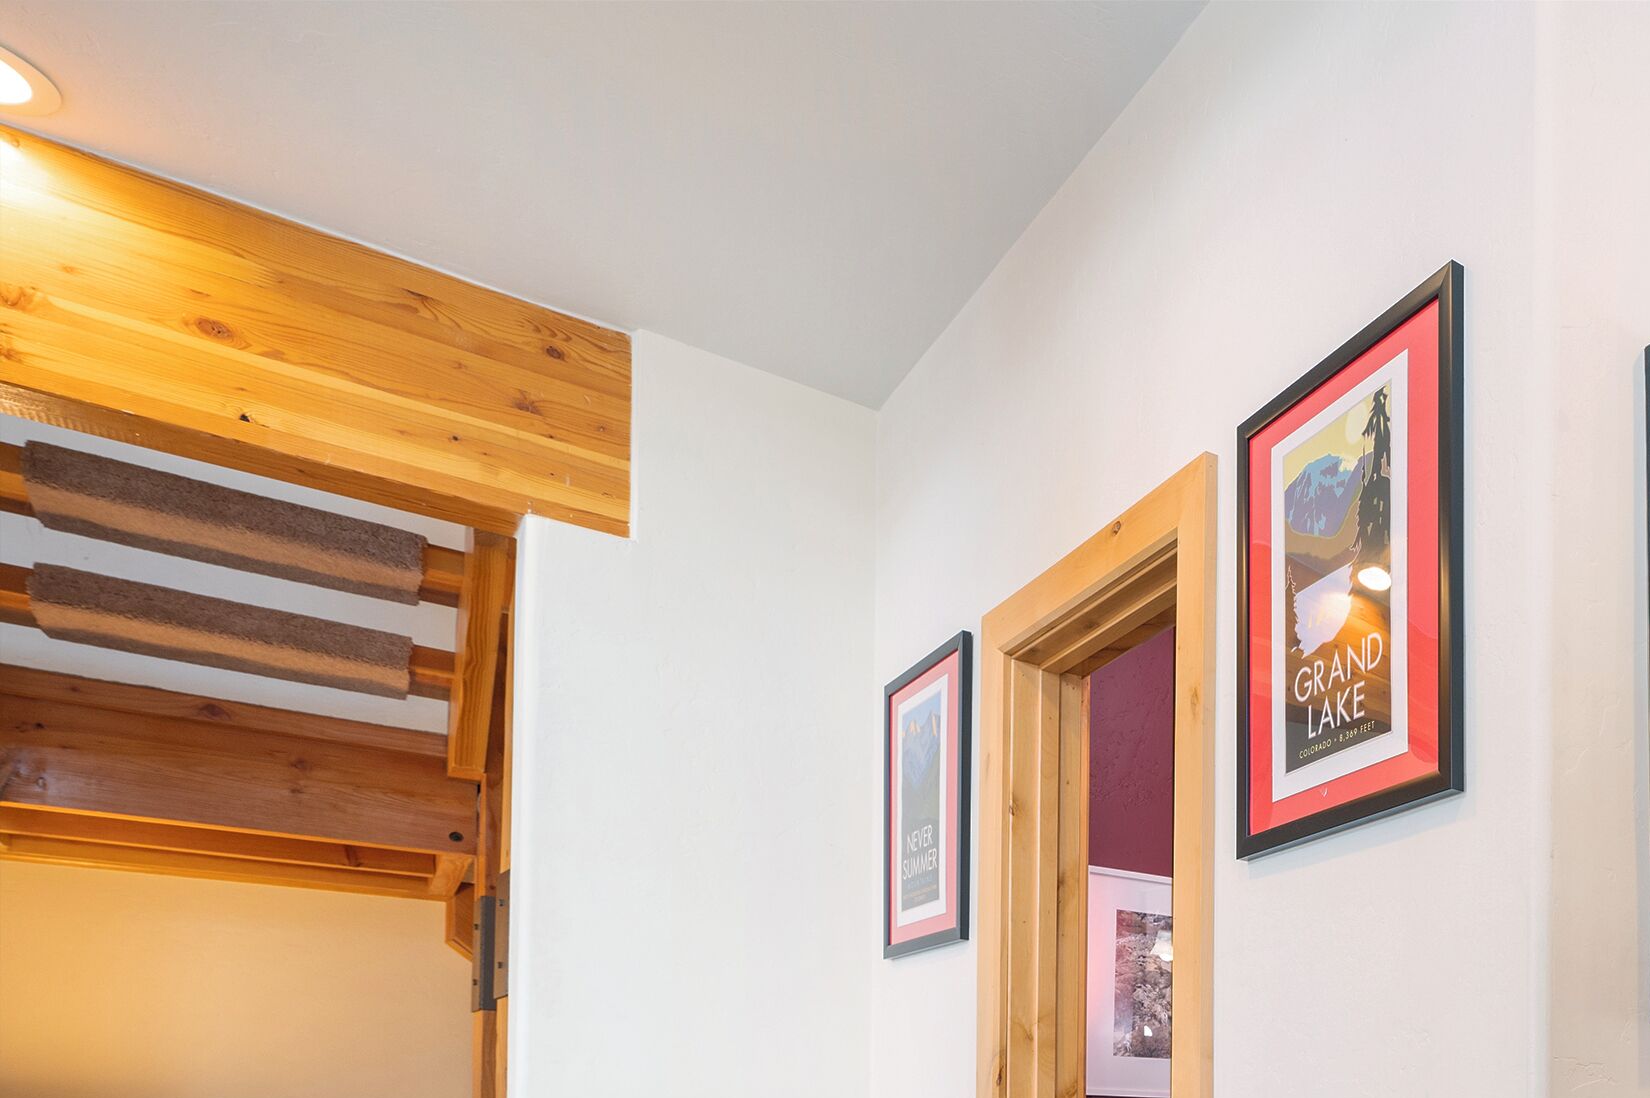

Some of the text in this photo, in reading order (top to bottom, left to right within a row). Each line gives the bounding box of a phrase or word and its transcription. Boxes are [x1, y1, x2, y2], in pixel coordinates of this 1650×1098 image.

[1294, 632, 1383, 702] GRAND
[1308, 680, 1365, 739] LAKE
[1299, 720, 1375, 759] COLORADO 8,369 FEET
[906, 824, 933, 854] NEVER
[902, 847, 938, 880] SUMMER
